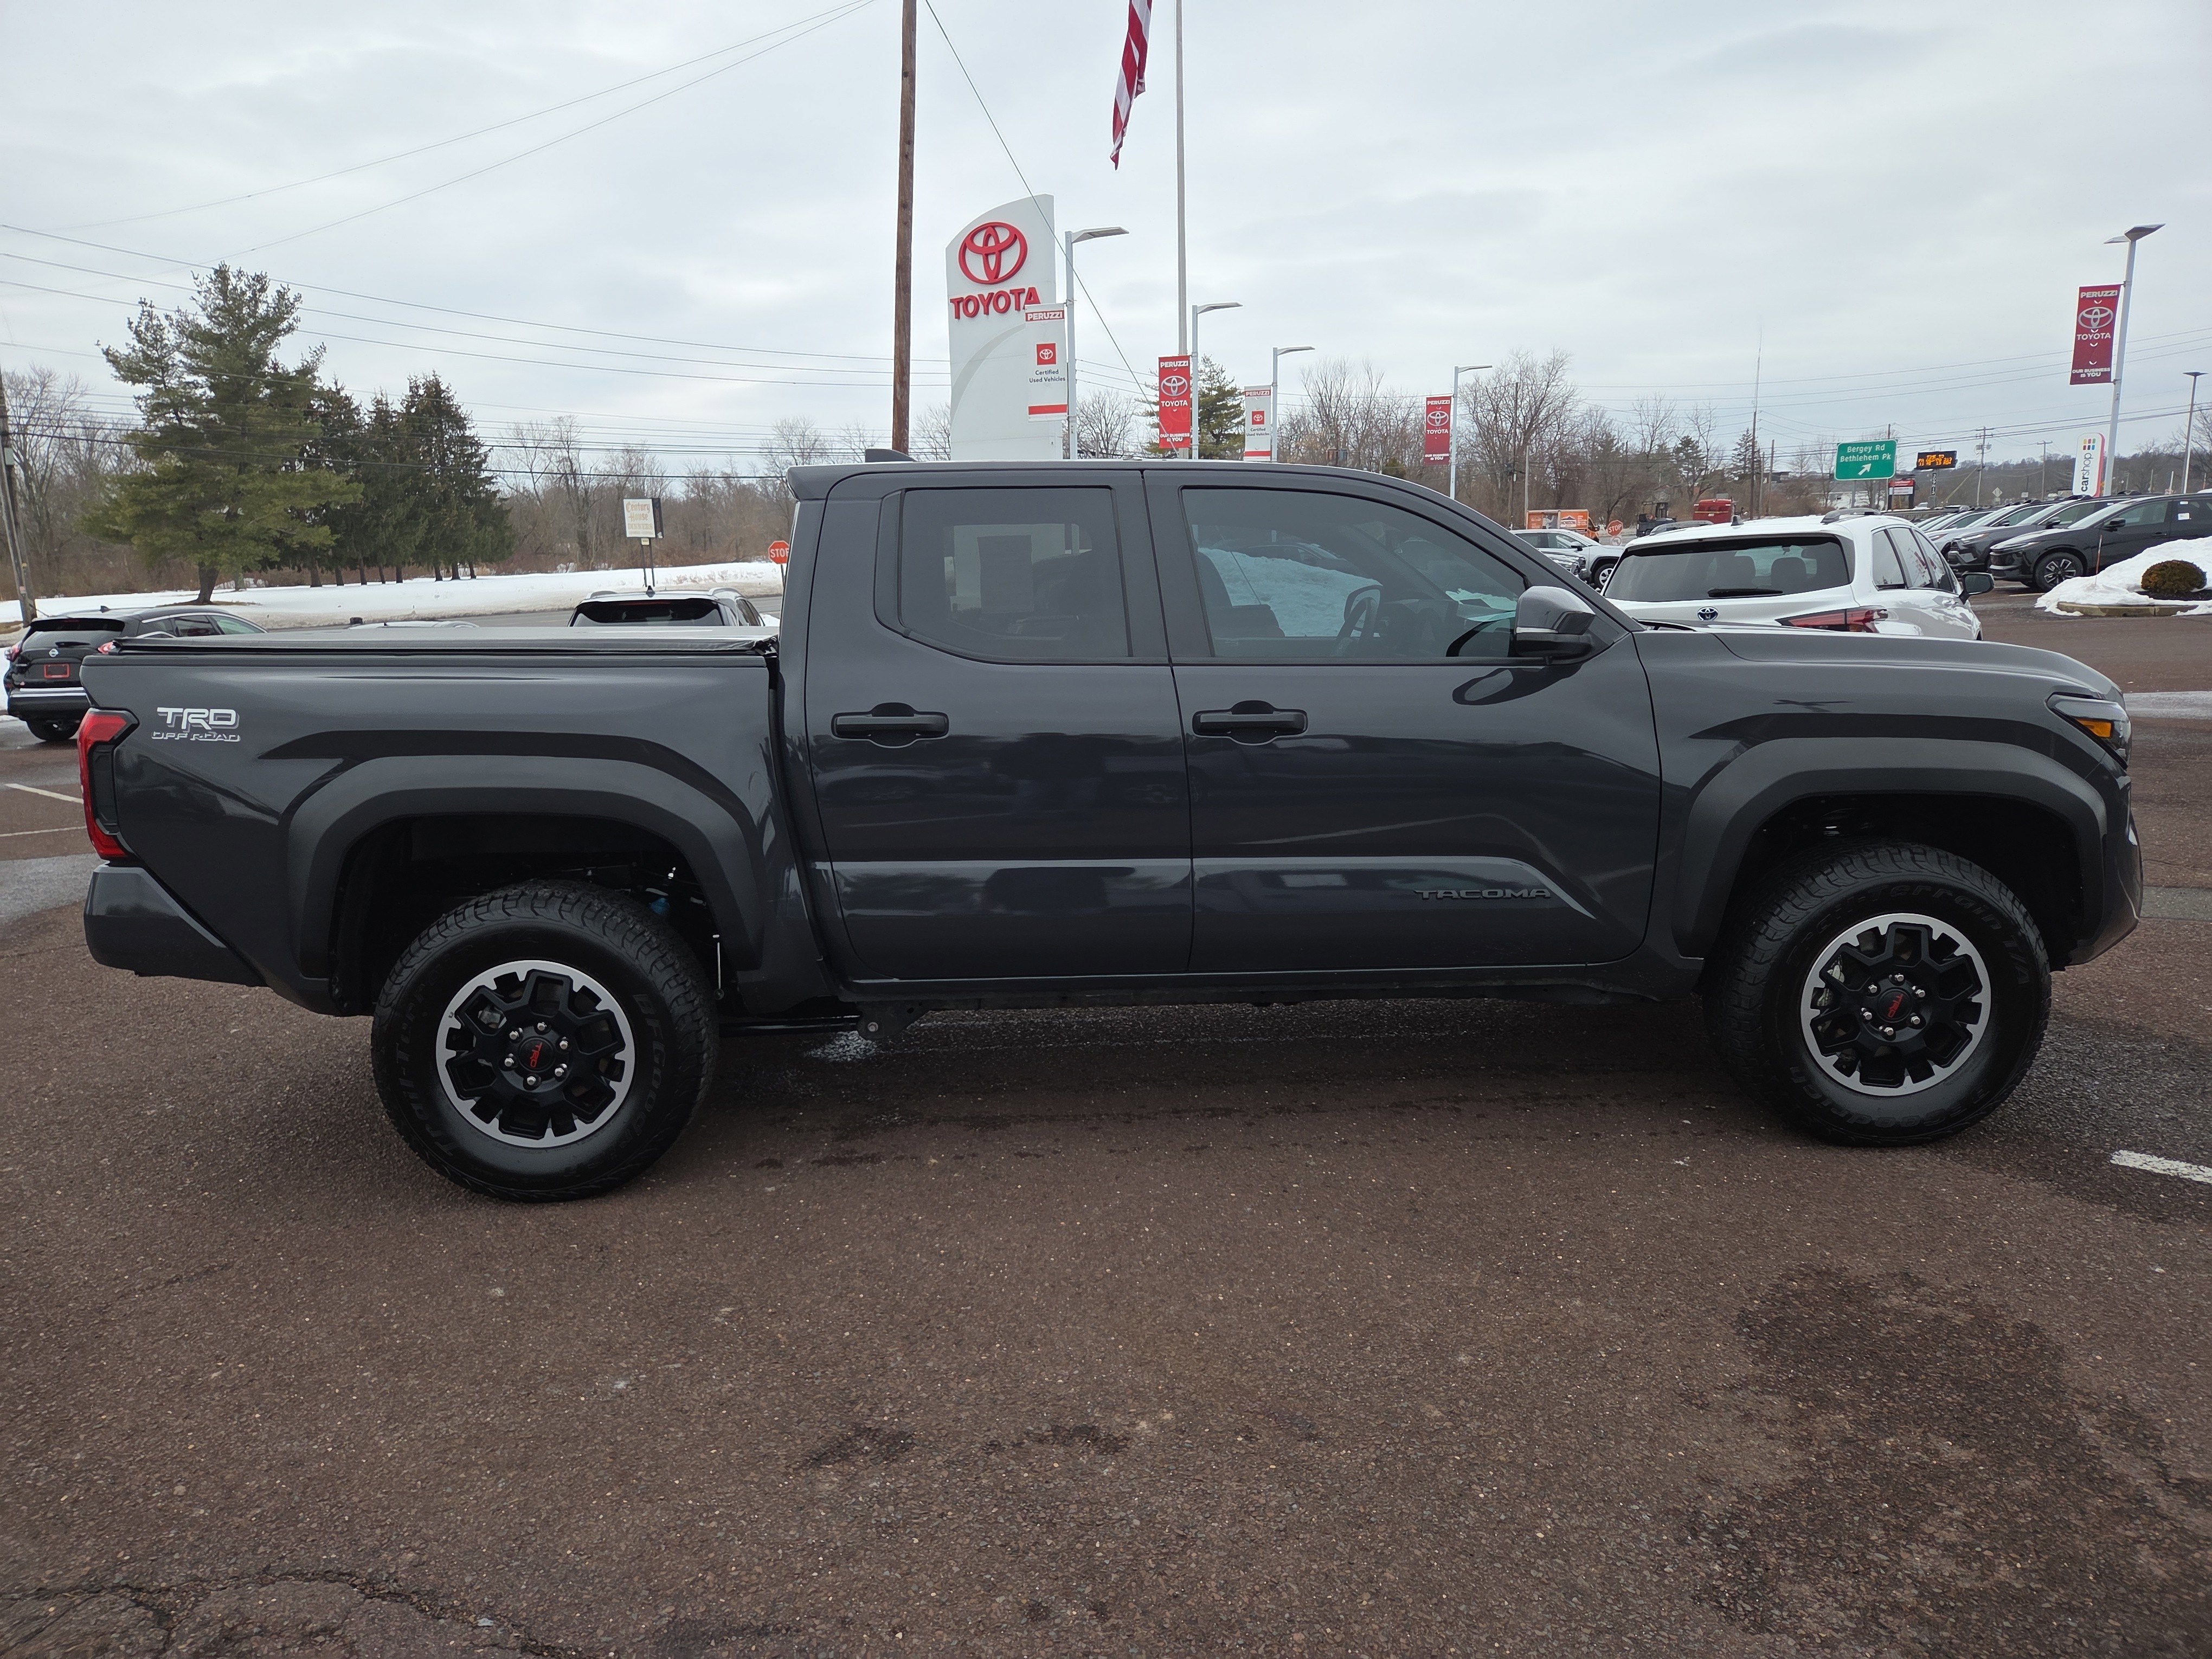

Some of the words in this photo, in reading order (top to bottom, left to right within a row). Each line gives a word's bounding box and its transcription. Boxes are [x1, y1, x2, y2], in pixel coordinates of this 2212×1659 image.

[2080, 290, 2118, 299] PERUZZI
[950, 287, 1040, 319] TOYOTA
[1027, 312, 1063, 320] PERUZZI
[2077, 332, 2111, 340] TOYOTA
[1847, 445, 1873, 454] Bergey
[1840, 454, 1879, 462] Bethlehem
[2081, 452, 2094, 492] carshop
[626, 501, 650, 513] Century
[1608, 523, 1622, 533] STOP
[770, 548, 789, 558] STOP
[157, 707, 239, 732] TRD
[151, 731, 188, 740] OFF
[190, 732, 241, 742] ROAD
[1413, 889, 1551, 900] TACOMA
[1888, 993, 1905, 1018] TRD
[530, 1042, 543, 1068] TRD
